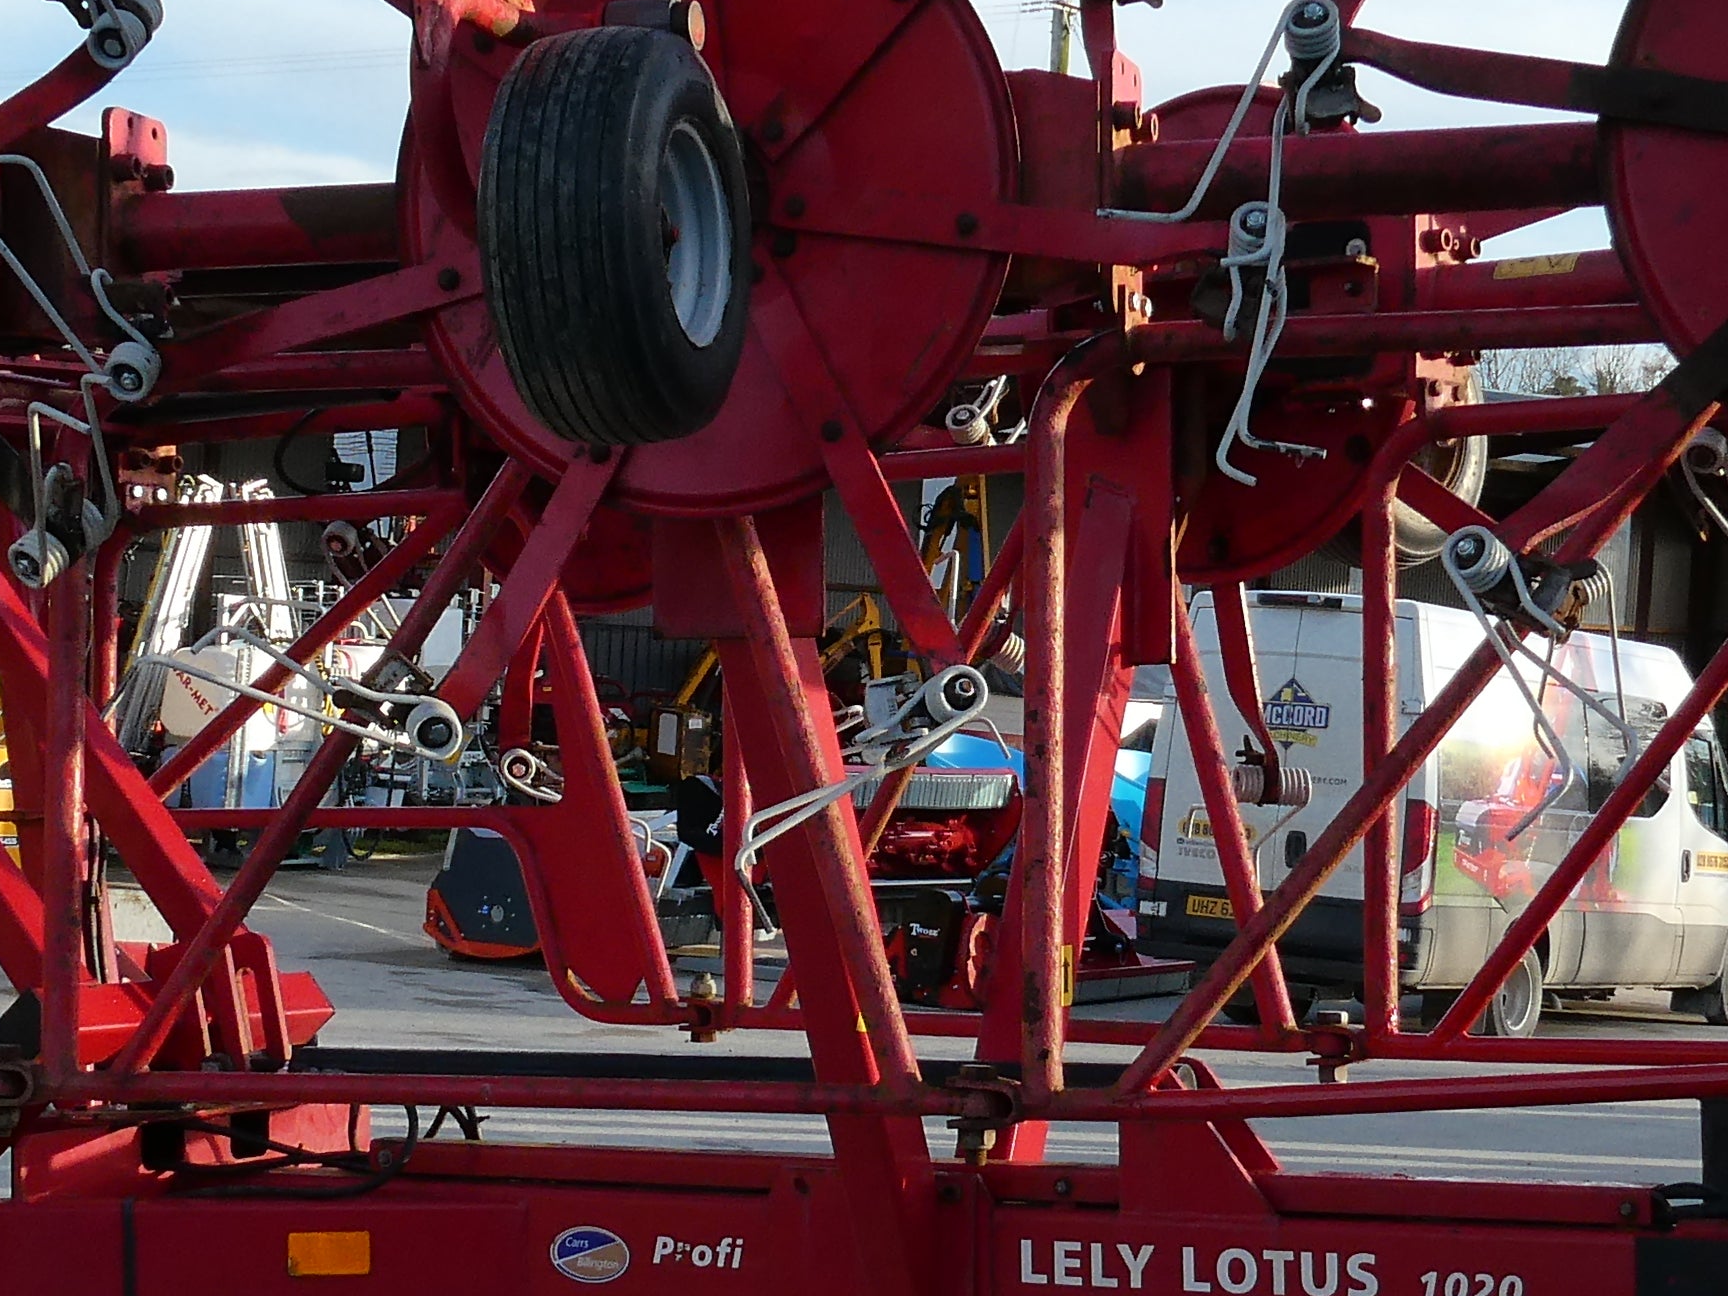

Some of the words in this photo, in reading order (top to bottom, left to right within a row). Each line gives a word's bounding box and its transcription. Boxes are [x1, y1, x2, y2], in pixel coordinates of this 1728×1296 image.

[173, 668, 214, 716] AR-MET
[1192, 899, 1218, 915] UHZ
[565, 1236, 589, 1248] Carrs
[576, 1257, 619, 1271] Billington
[1020, 1239, 1155, 1288] LELY
